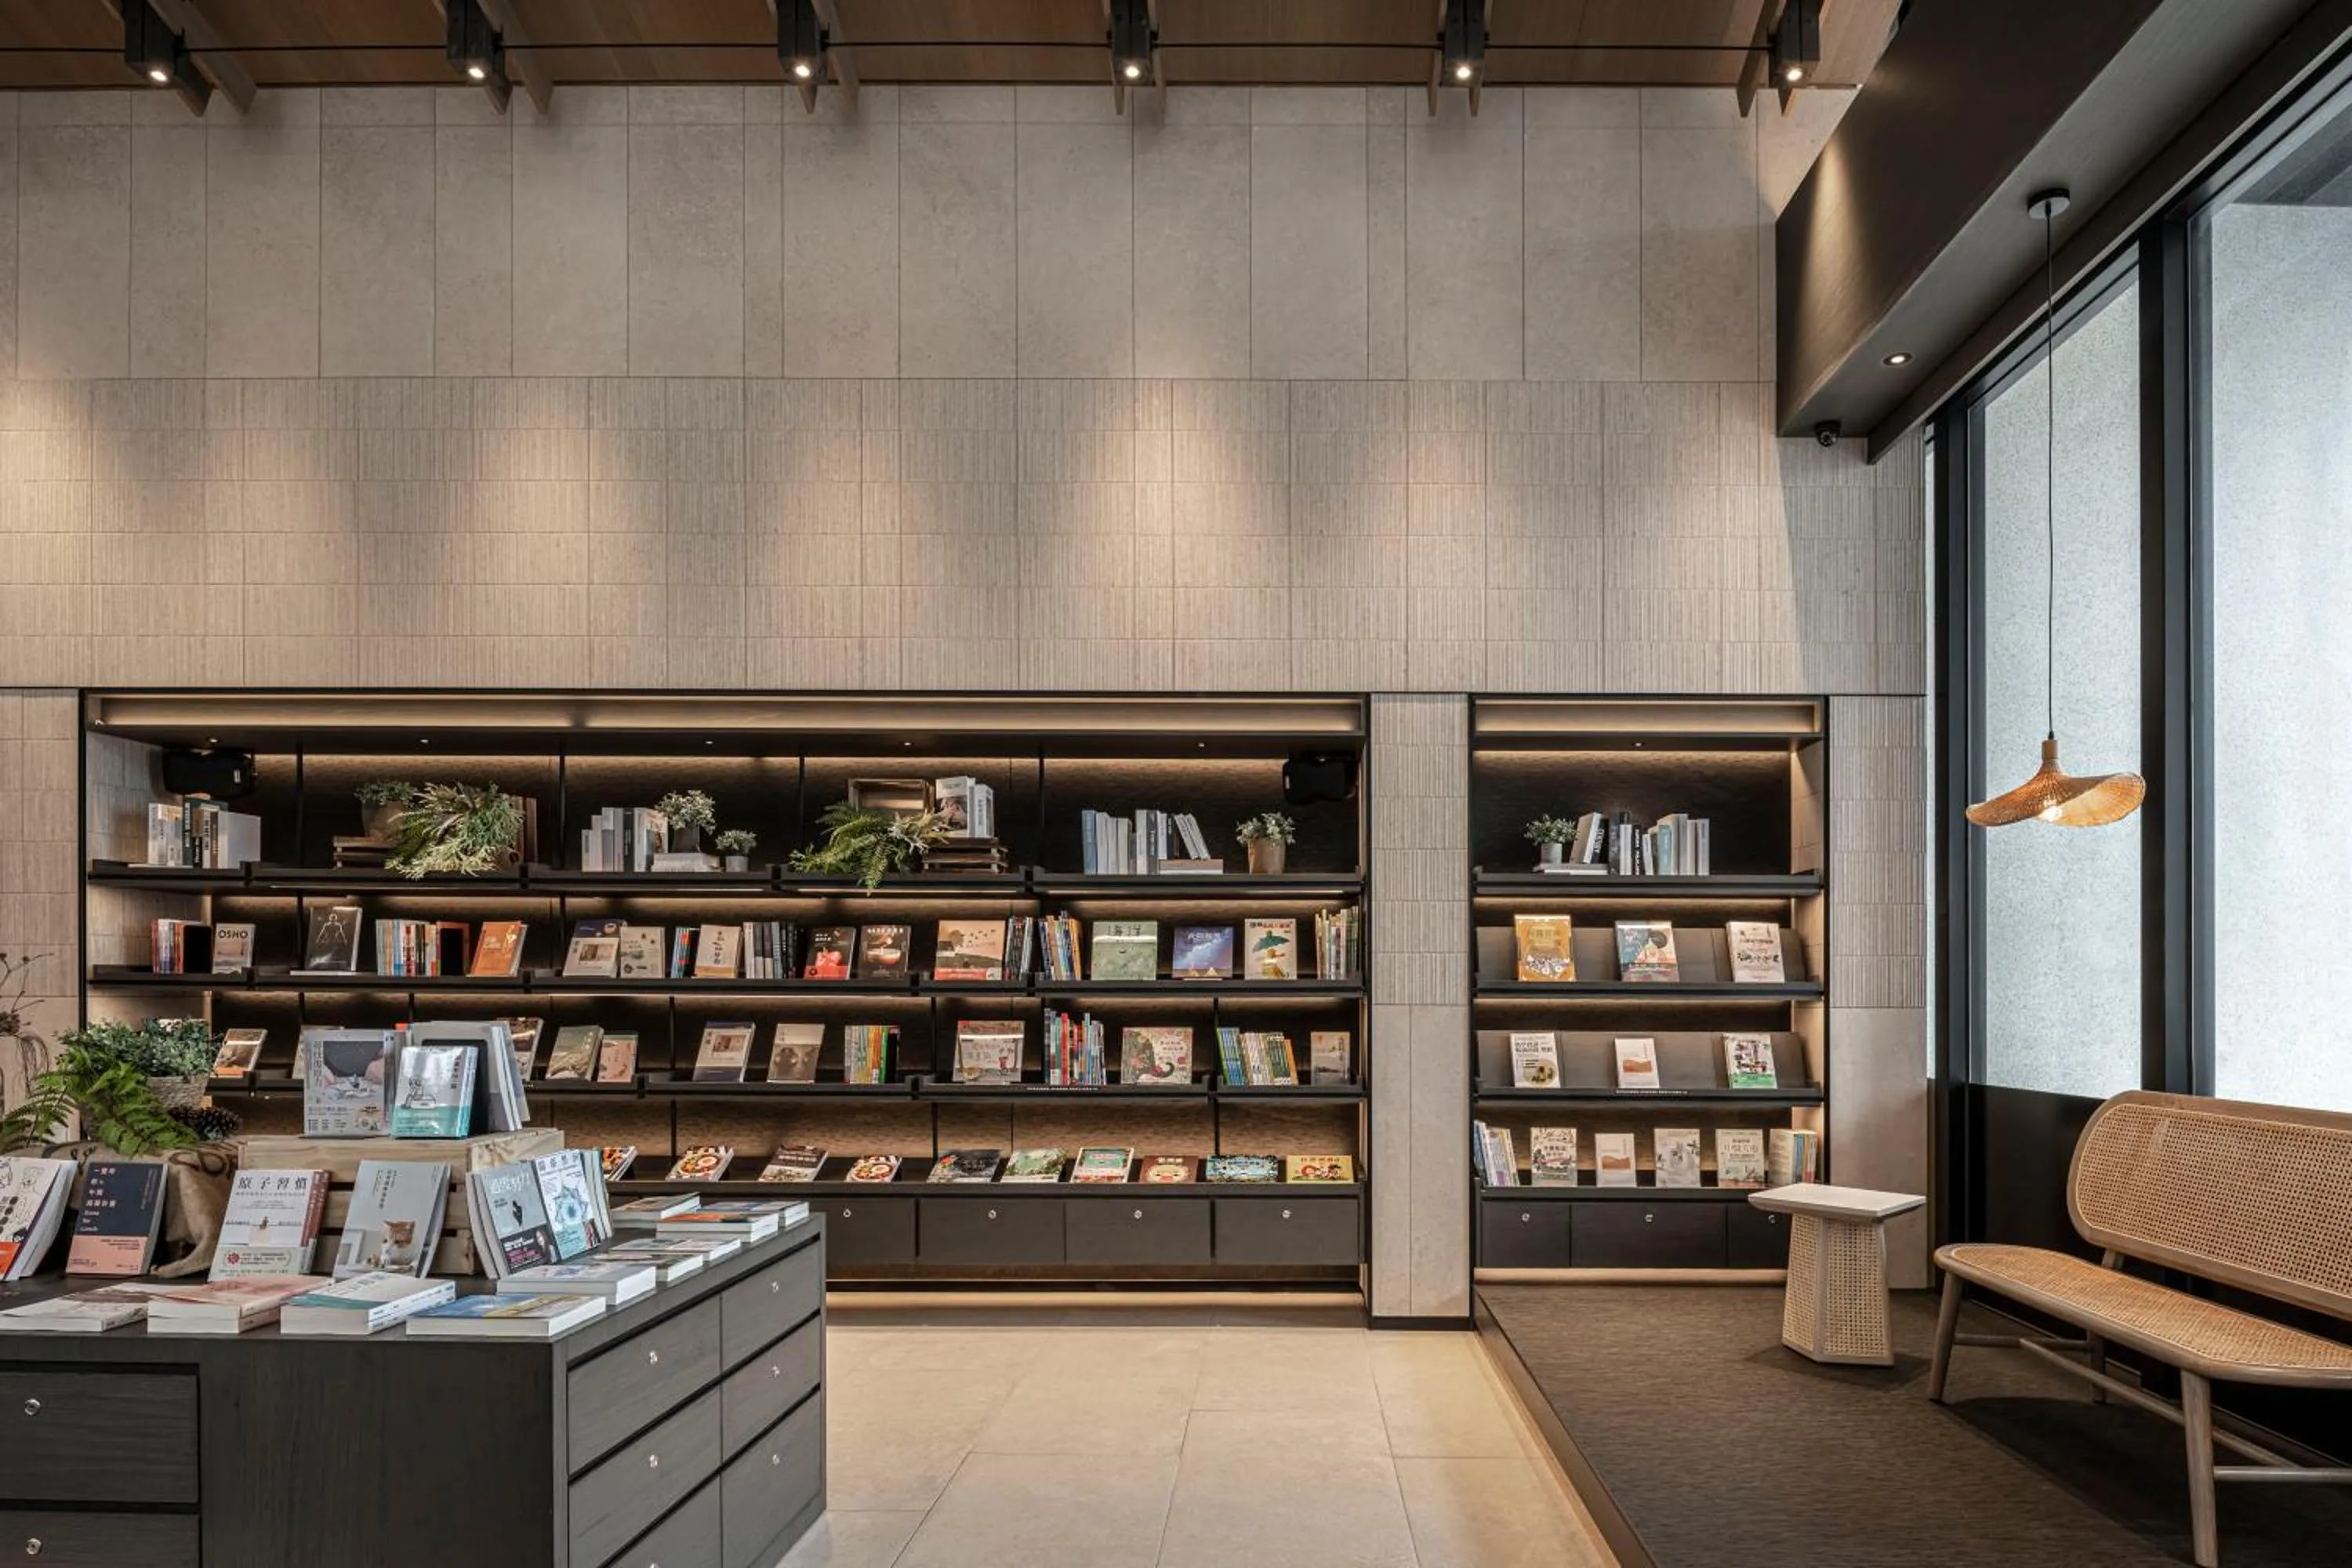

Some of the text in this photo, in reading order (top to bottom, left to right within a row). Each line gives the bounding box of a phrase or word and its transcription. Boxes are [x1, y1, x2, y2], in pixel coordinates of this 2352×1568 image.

[218, 929, 249, 939] OSHO
[238, 1176, 308, 1190] 原子習慣
